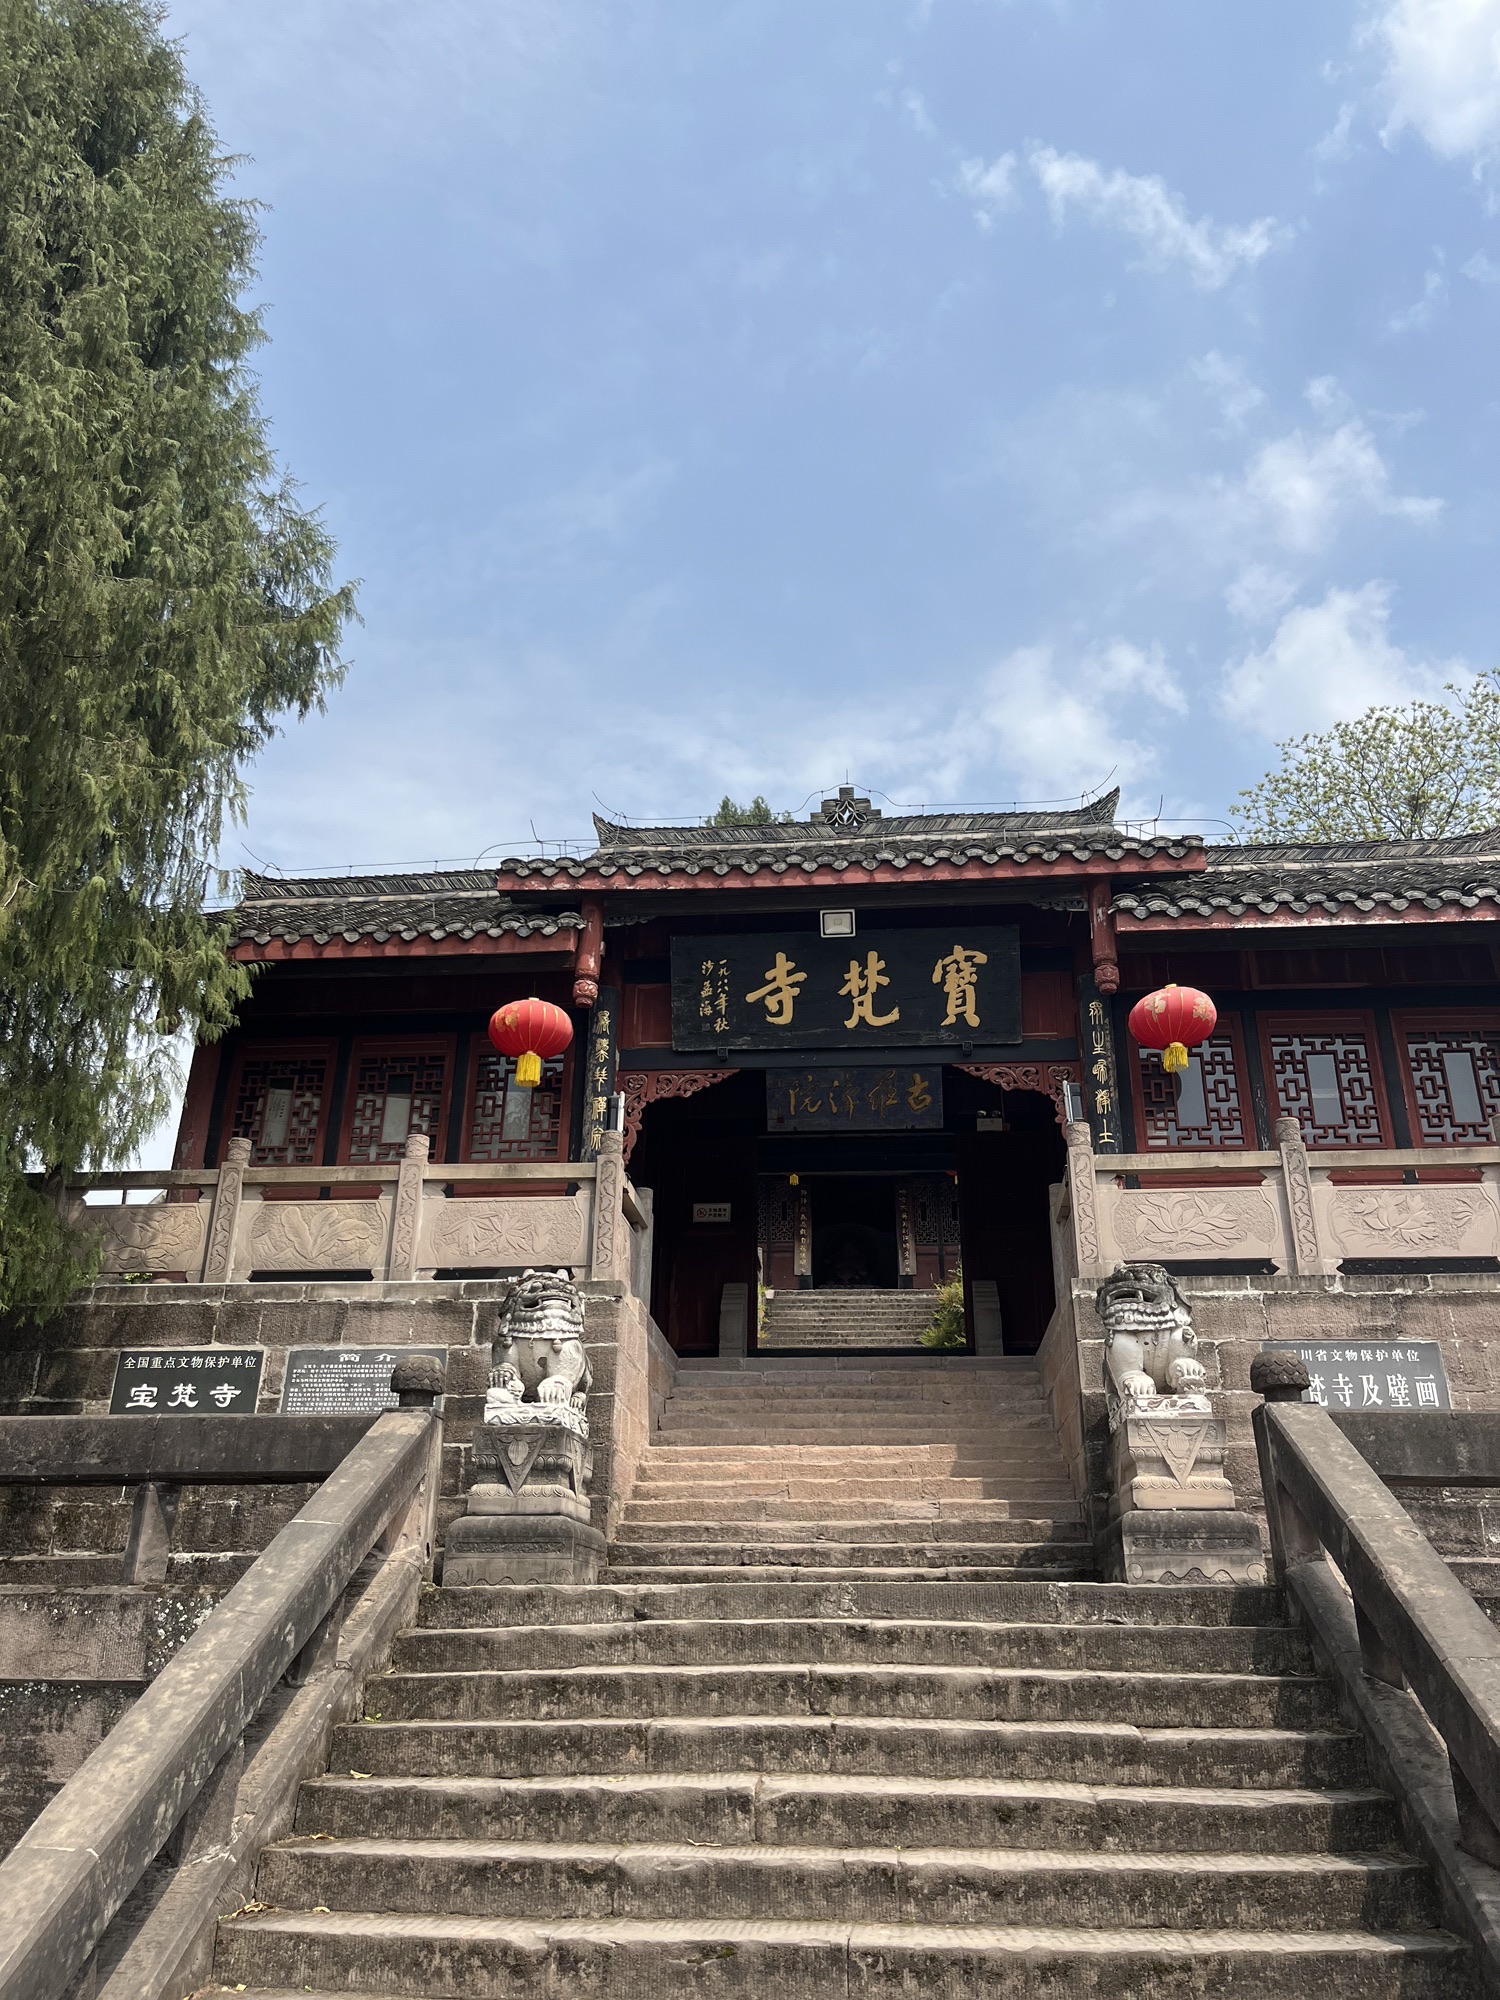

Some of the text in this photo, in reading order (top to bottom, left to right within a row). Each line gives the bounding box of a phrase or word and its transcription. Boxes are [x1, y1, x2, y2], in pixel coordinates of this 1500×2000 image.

[699, 960, 714, 1017] 沙孟海
[713, 958, 731, 1034] 一九八八年秋
[745, 945, 988, 1028] 寶梵寺
[123, 1356, 257, 1369] 全国重点文物保护单位
[339, 1353, 398, 1362] 简介
[1293, 1349, 1420, 1362] 川省文物保护单位
[125, 1383, 242, 1408] 宝梵寺
[1308, 1372, 1440, 1408] 梵寺及壁画
